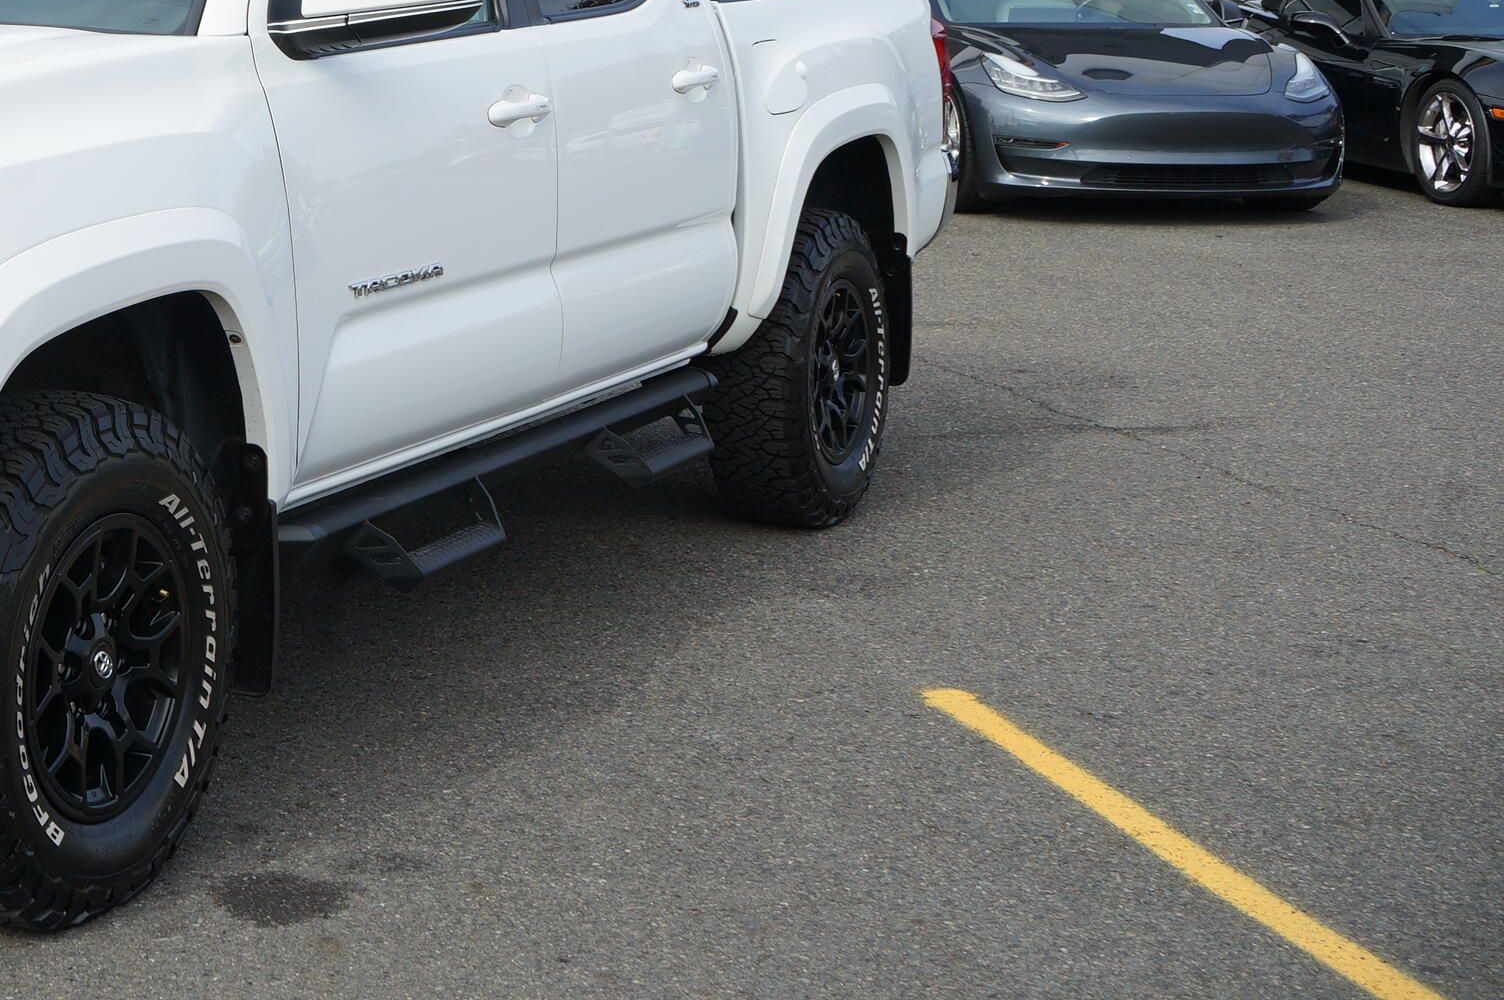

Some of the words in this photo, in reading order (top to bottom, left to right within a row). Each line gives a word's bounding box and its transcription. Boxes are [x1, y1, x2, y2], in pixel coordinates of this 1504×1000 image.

[349, 262, 443, 299] TACOMA
[158, 494, 219, 709] All-Terrain
[174, 720, 207, 788] T/A
